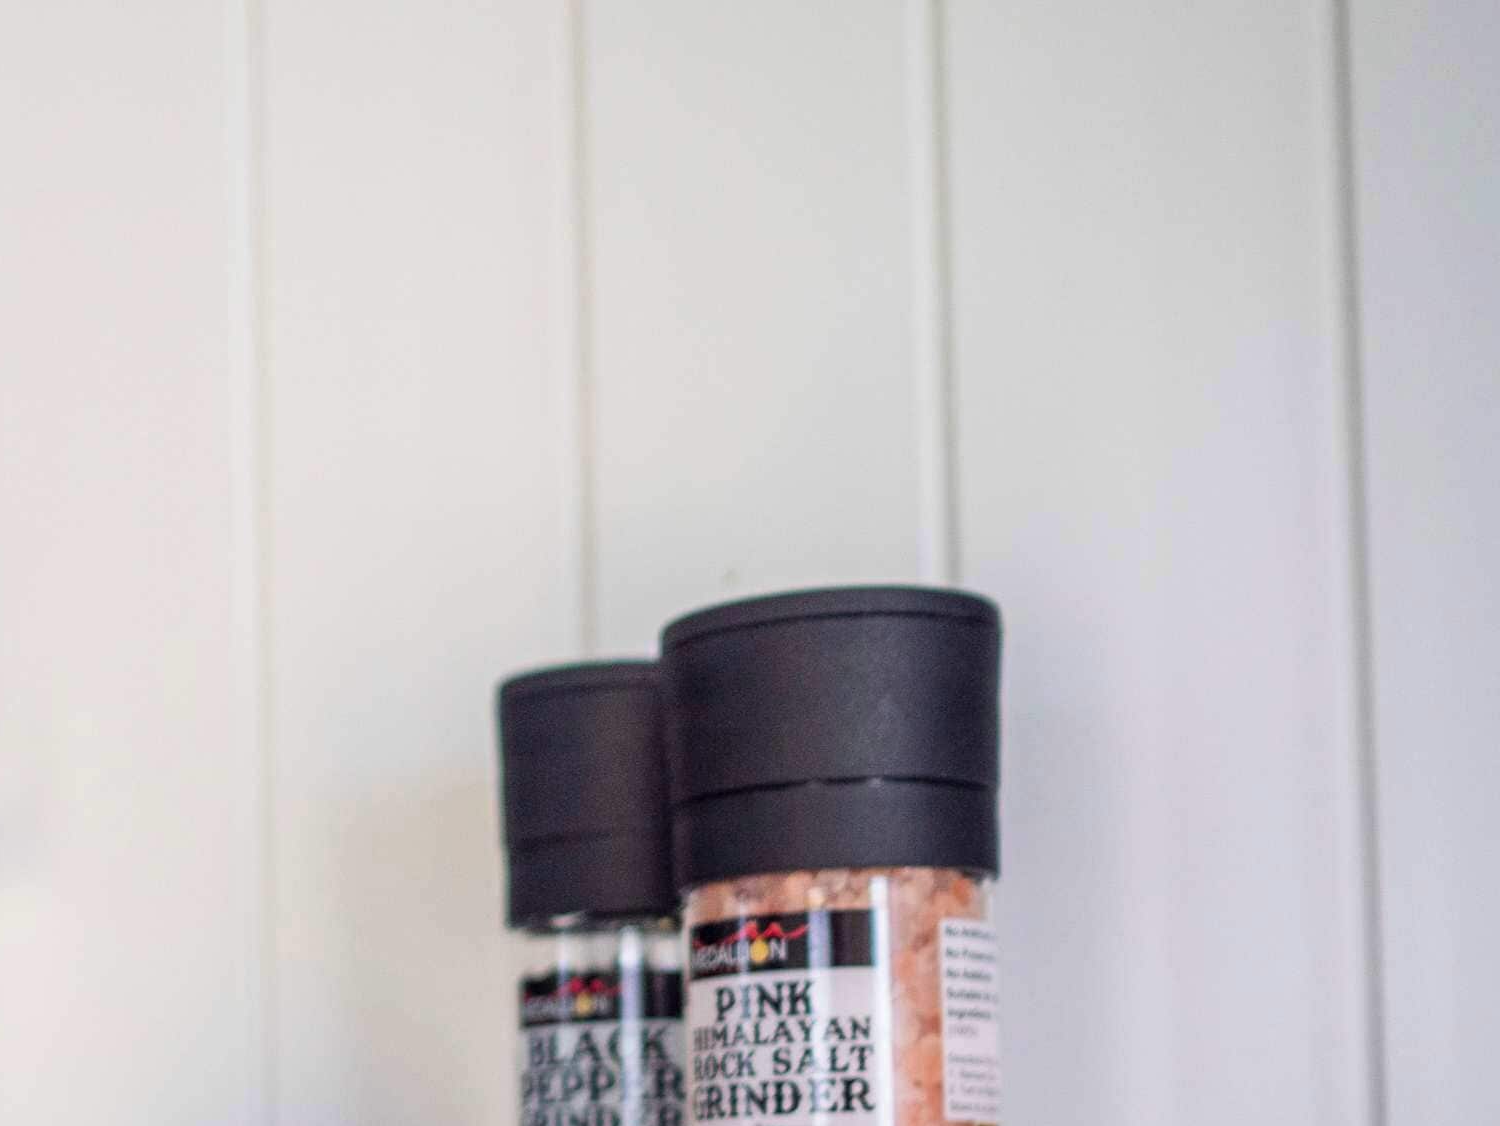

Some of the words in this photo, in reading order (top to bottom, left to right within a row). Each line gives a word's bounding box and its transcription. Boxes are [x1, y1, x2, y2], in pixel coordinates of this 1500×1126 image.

[716, 980, 813, 1022] PINK
[694, 1016, 871, 1051] HIMALAYAN
[694, 1050, 757, 1081] ROCK
[770, 1044, 875, 1076] SALT
[521, 1064, 687, 1106] PEPPR
[693, 1076, 876, 1121] GRINDER
